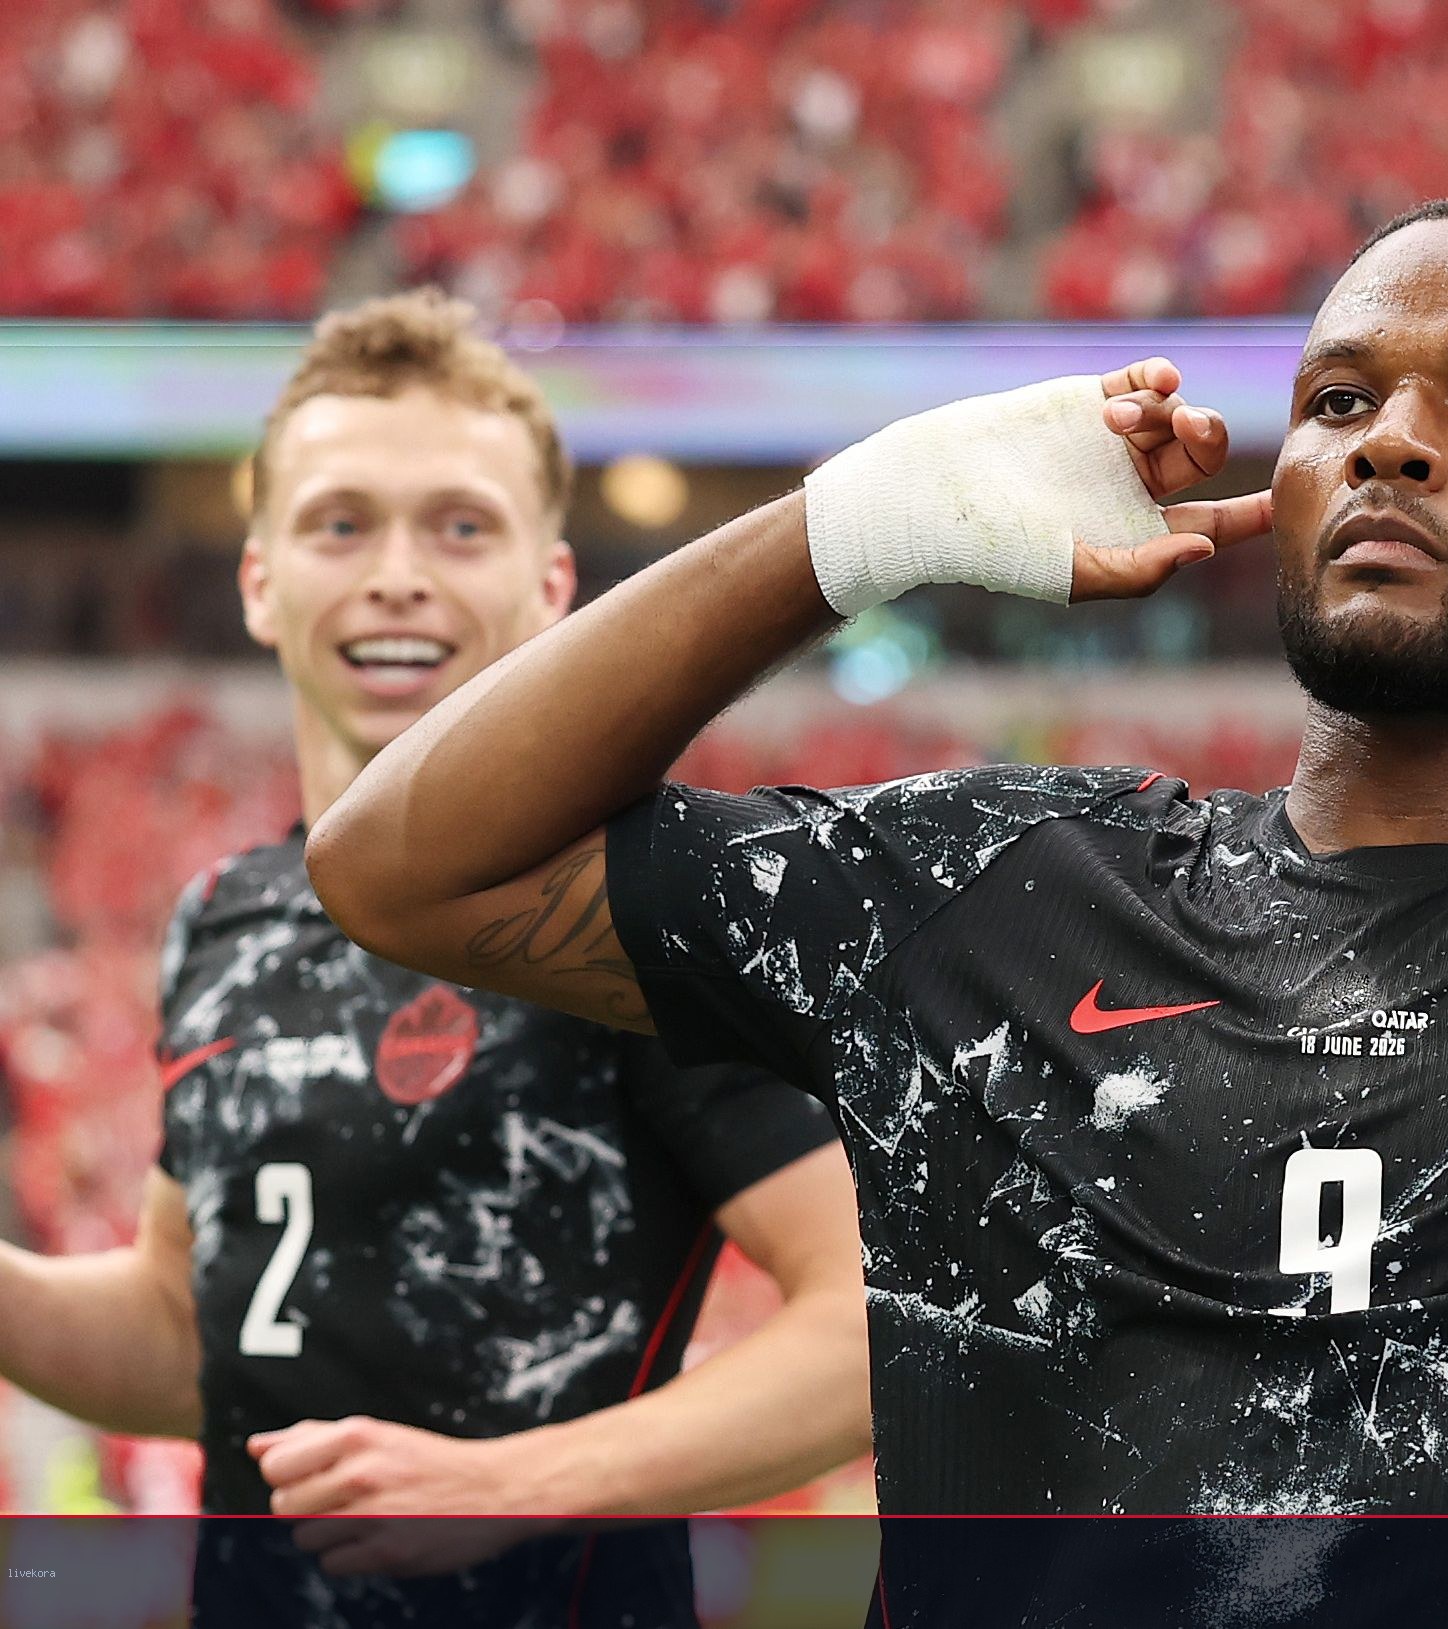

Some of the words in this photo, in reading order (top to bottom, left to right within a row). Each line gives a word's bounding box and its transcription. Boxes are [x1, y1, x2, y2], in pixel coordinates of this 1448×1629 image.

[1300, 1035, 1316, 1054] 18
[1322, 1035, 1363, 1056] JUNE
[1369, 1037, 1406, 1057] 2026
[1371, 1009, 1429, 1030] QATAR
[238, 1161, 315, 1358] 2
[1269, 1148, 1383, 1315] 9
